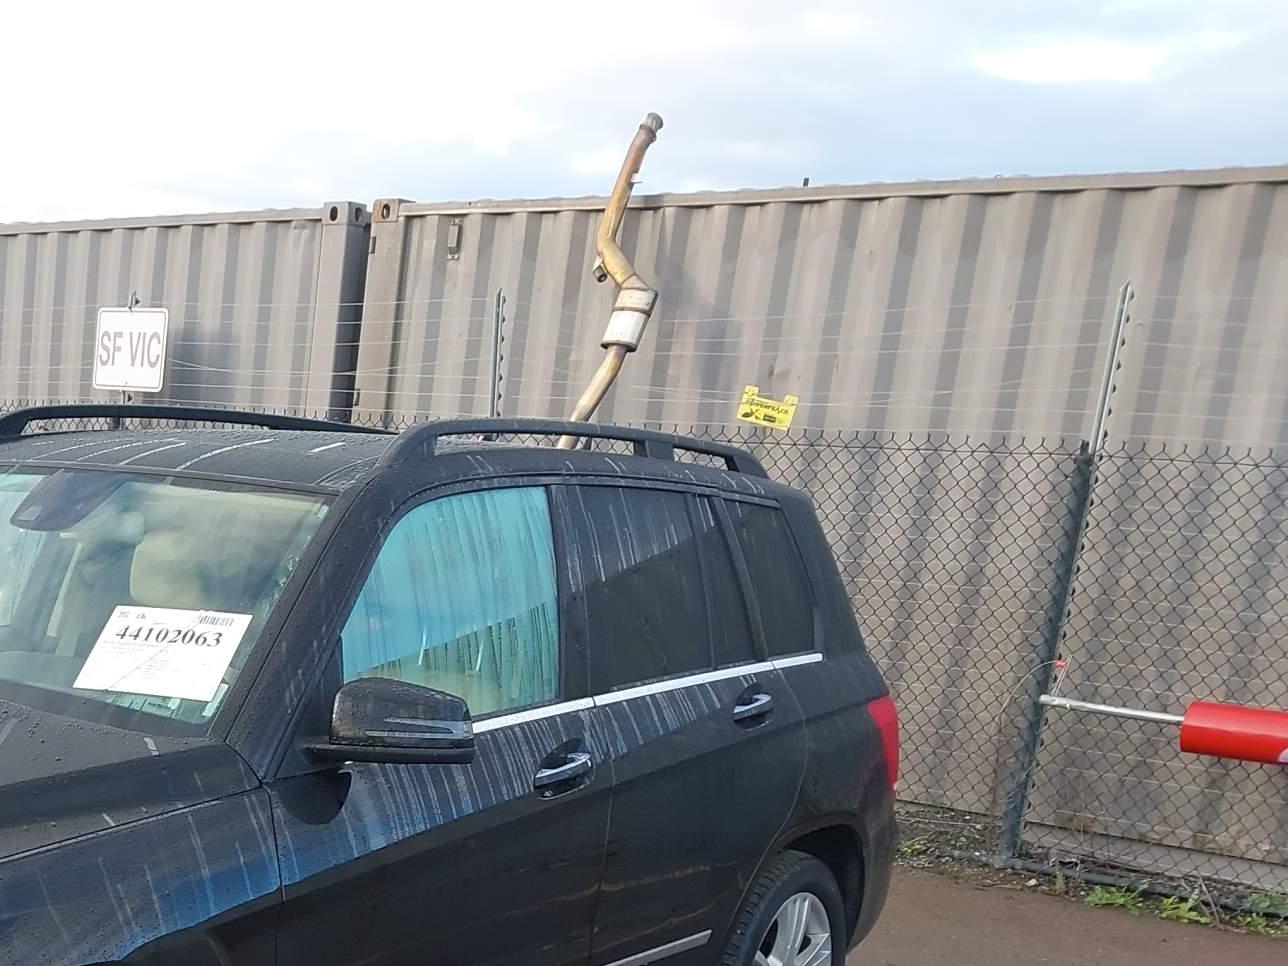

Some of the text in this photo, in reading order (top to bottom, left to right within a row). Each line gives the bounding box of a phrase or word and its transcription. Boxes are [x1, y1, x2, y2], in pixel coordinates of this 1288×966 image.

[99, 331, 161, 368] SF VIC
[115, 625, 223, 647] 44102063
